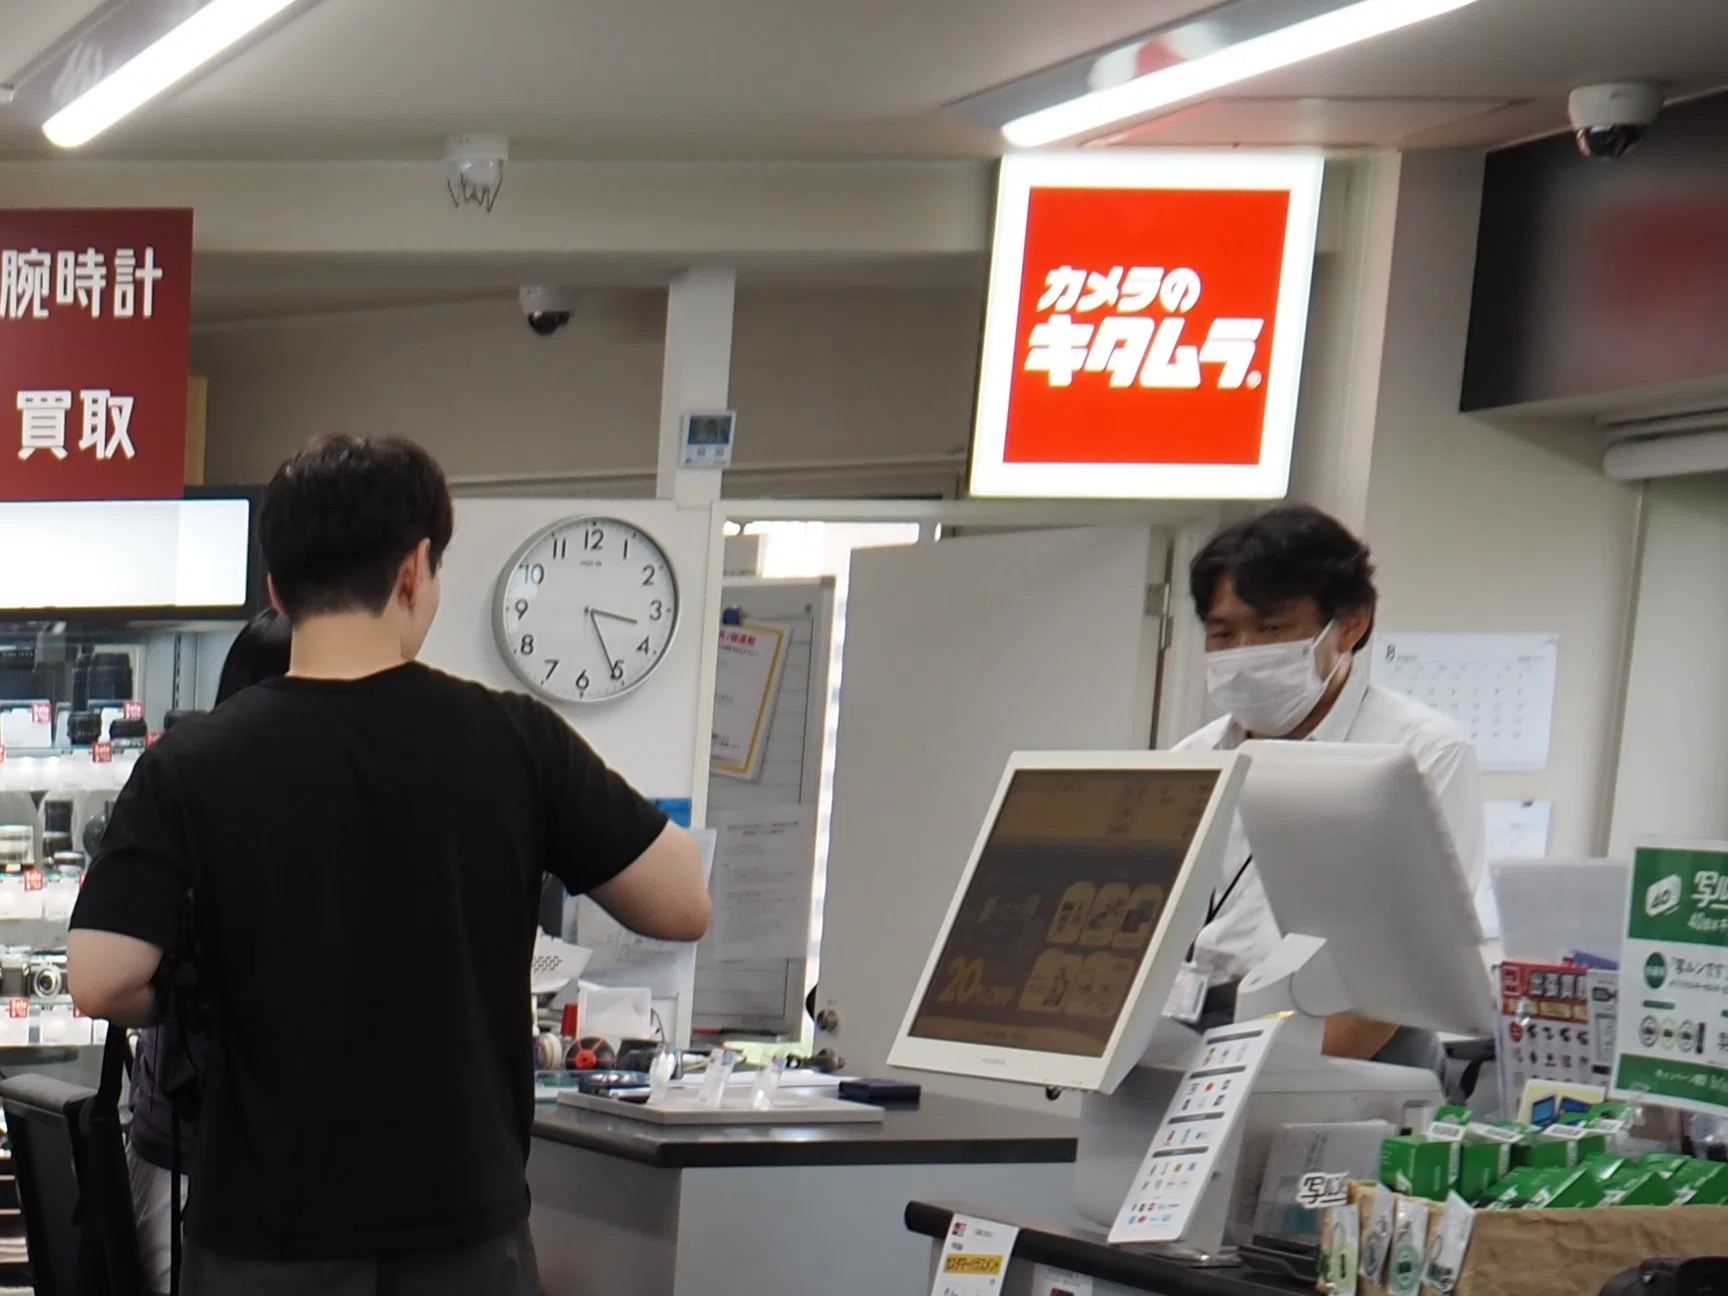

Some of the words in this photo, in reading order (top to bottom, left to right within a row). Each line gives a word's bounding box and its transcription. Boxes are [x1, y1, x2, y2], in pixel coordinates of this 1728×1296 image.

[1036, 265, 1202, 314] カメラの
[1023, 313, 1264, 392] キタムラ
[14, 387, 136, 463] 買取
[553, 538, 566, 560] 11
[584, 529, 604, 550] 12
[622, 539, 629, 560] 1
[524, 563, 545, 585] 10
[642, 564, 656, 586] 2
[515, 599, 529, 620] 9
[649, 600, 663, 621] 3
[520, 634, 534, 655] 8
[636, 636, 650, 655] 4
[544, 659, 560, 680] 7
[576, 669, 590, 690] 6
